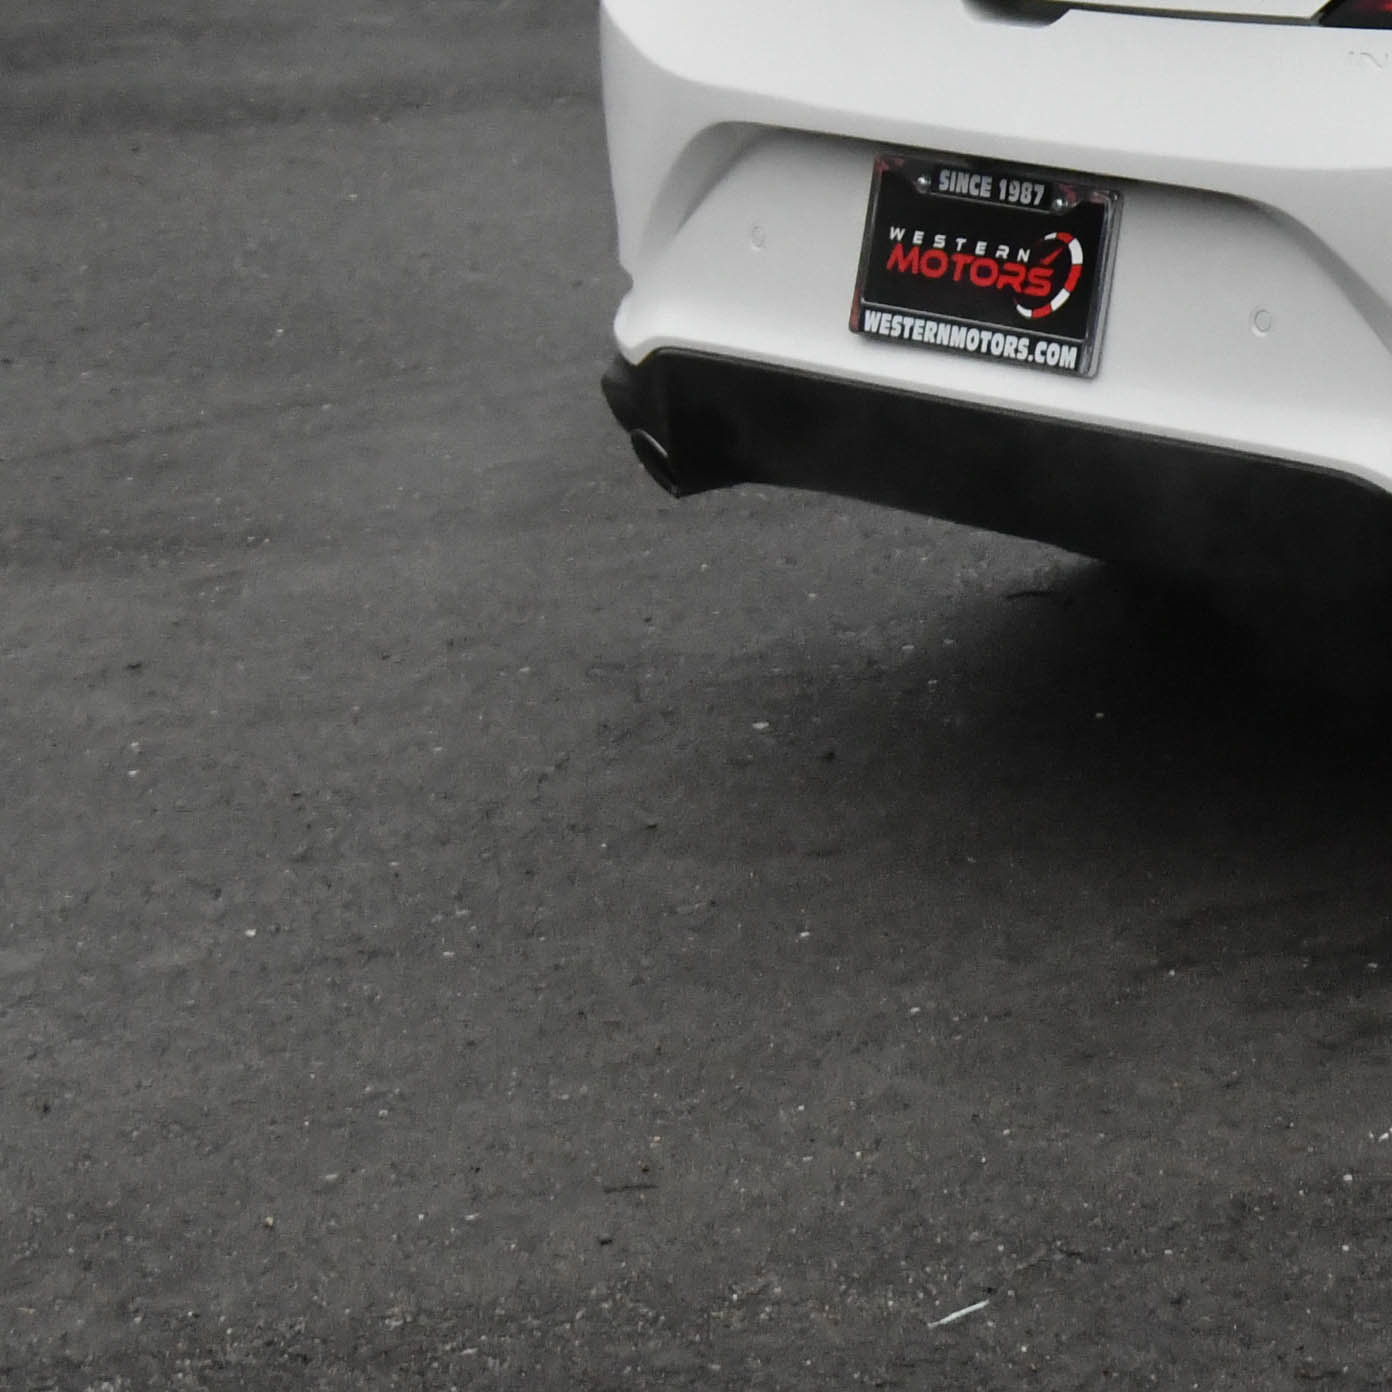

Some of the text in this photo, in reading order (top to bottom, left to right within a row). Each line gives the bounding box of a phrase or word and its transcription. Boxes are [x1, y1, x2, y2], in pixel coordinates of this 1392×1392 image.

[939, 169, 1046, 206] SINCE 1987
[889, 226, 1031, 264] WESTERN
[886, 244, 1056, 298] MOTORS
[863, 309, 1079, 370] WESTERNMOTORS.COM
